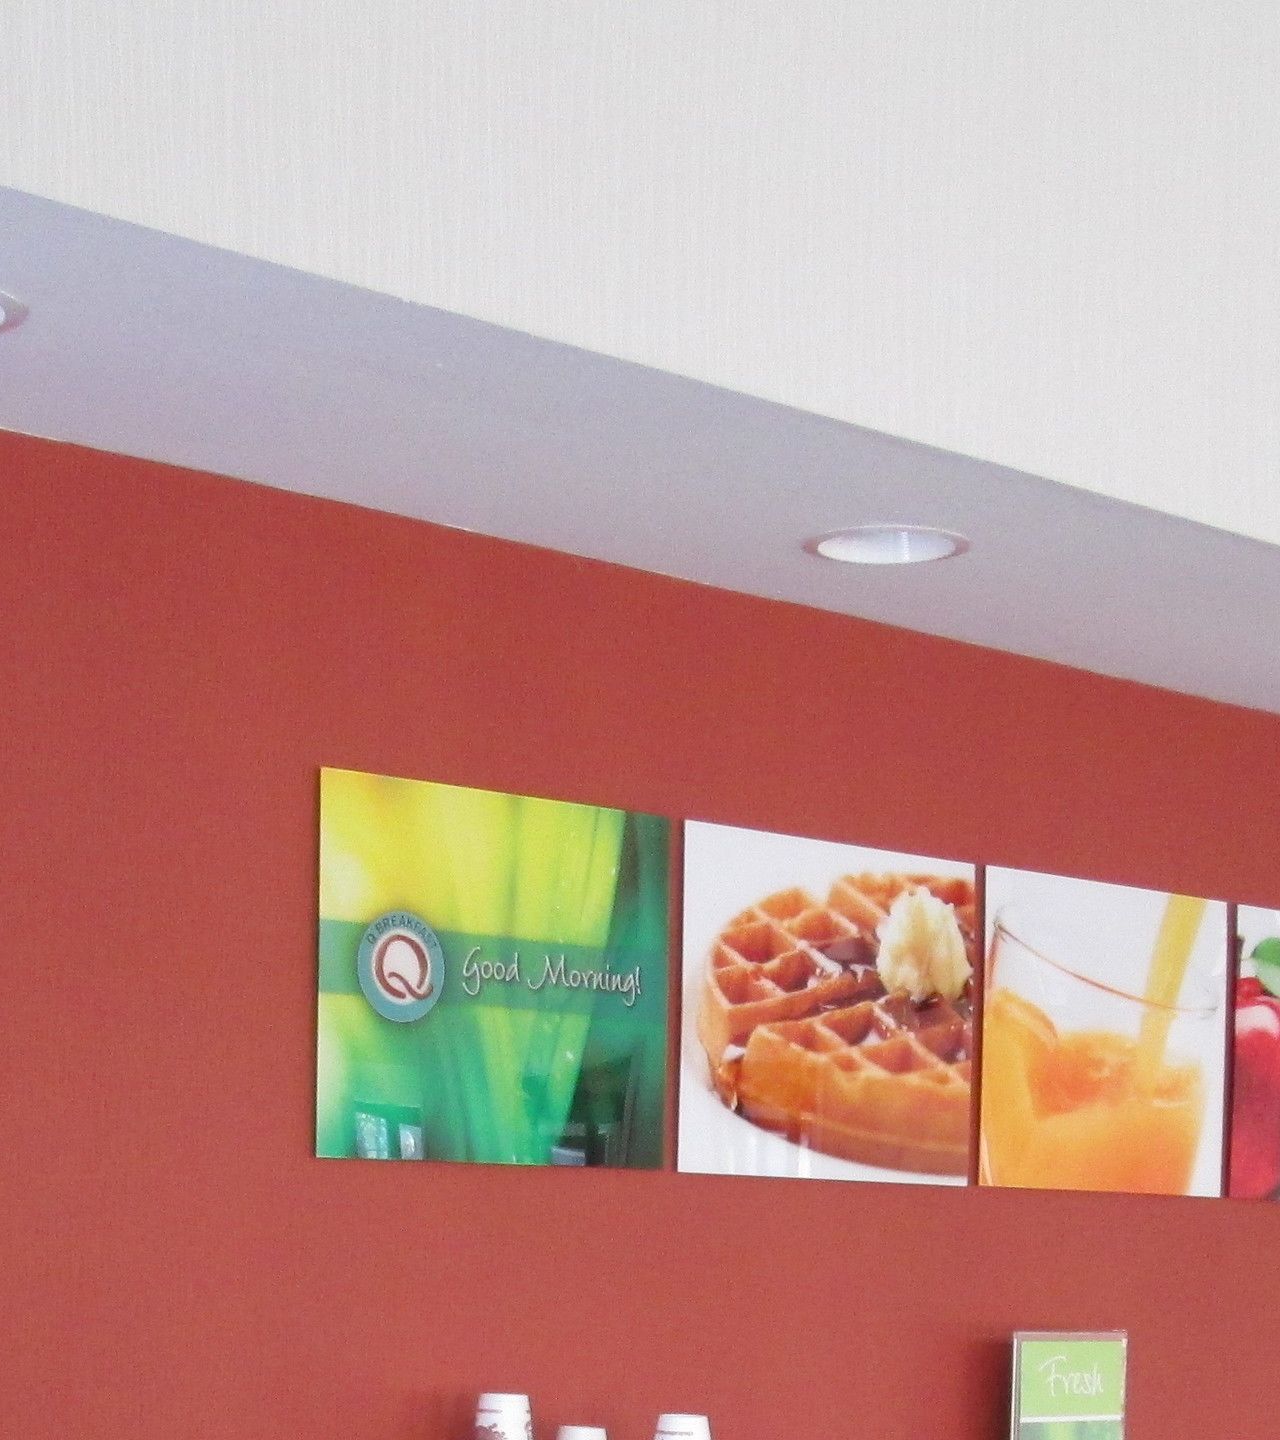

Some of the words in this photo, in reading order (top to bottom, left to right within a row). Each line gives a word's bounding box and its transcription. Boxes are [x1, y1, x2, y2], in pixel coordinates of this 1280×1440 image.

[374, 933, 434, 1000] Q
[462, 945, 520, 996] Good
[527, 953, 642, 1007] Morning!
[1038, 1354, 1105, 1397] Fresh
